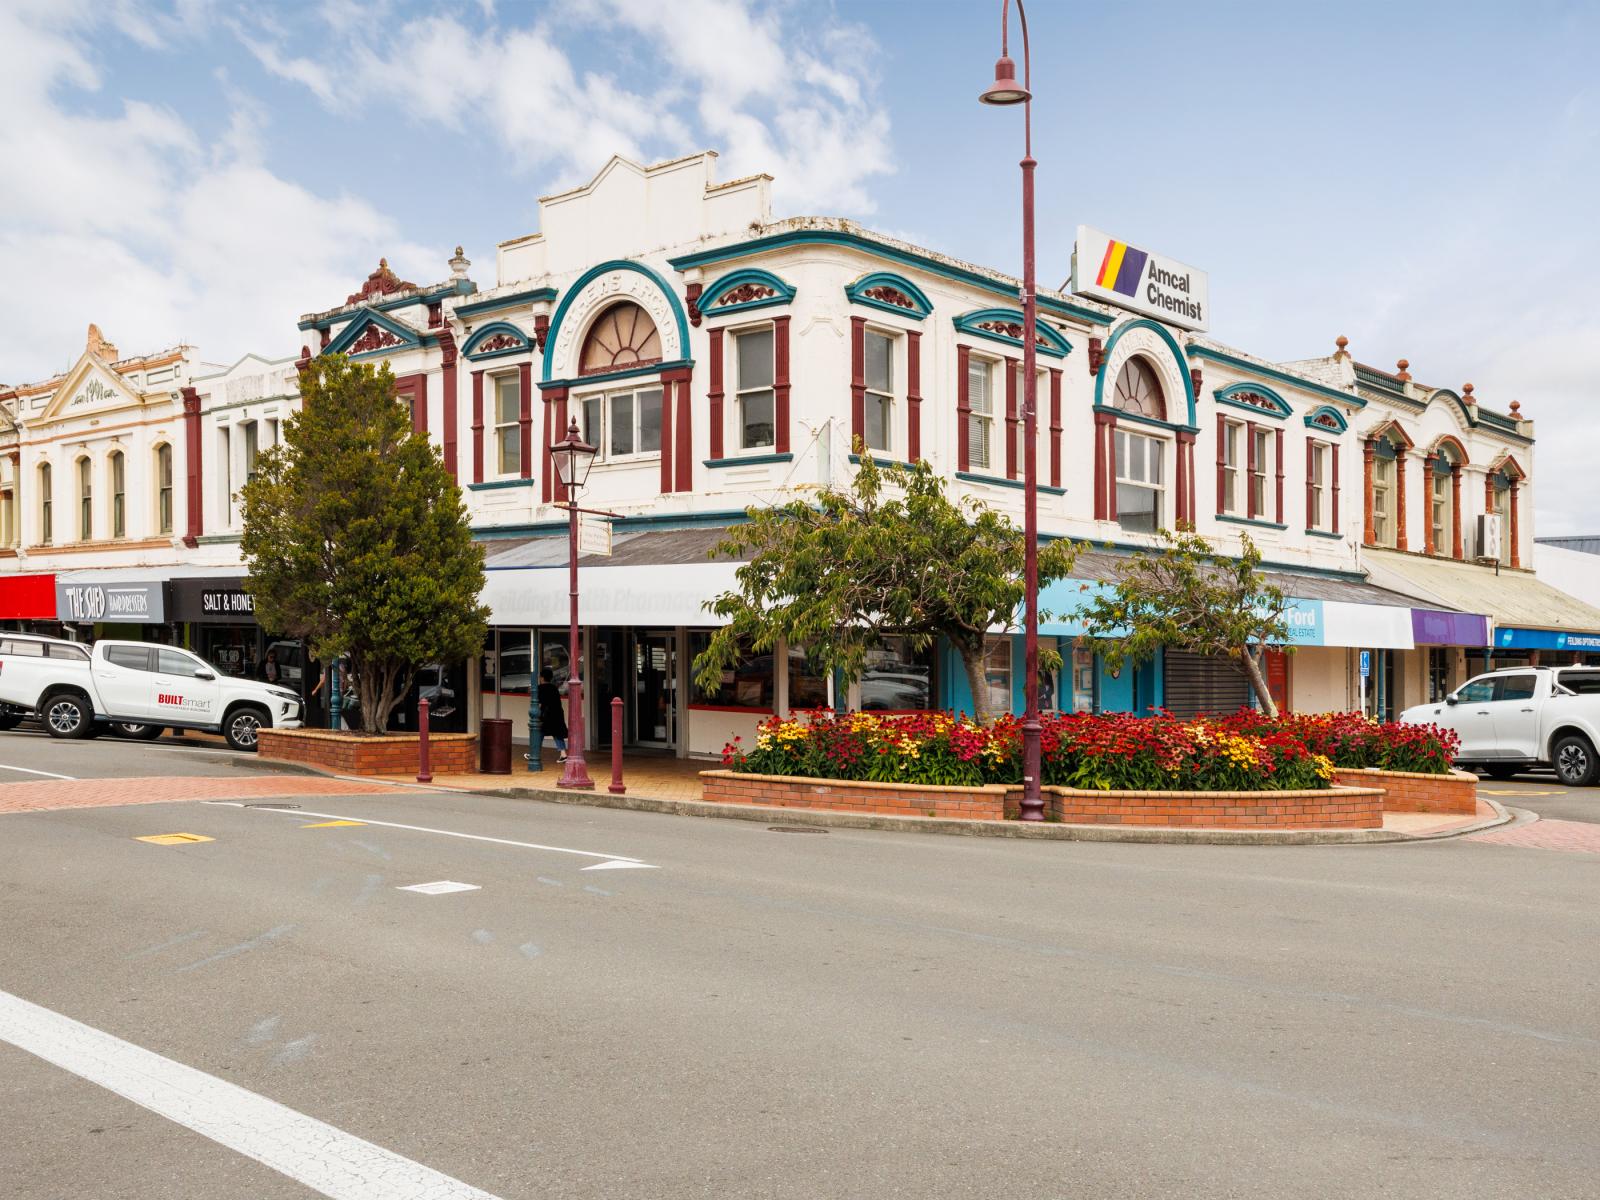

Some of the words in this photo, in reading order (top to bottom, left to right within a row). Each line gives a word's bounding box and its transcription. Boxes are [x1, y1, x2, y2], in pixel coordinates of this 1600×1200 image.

[1148, 259, 1190, 293] Amcal
[1146, 284, 1202, 321] Chemist
[65, 587, 84, 619] THE
[85, 586, 106, 619] SHED
[109, 594, 147, 613] HAIRDRESSERS
[203, 594, 221, 611] SALT
[223, 594, 230, 611] &
[1287, 608, 1315, 626] Ford
[1299, 628, 1316, 638] ESTATE
[158, 693, 210, 708] BUILTsmart
